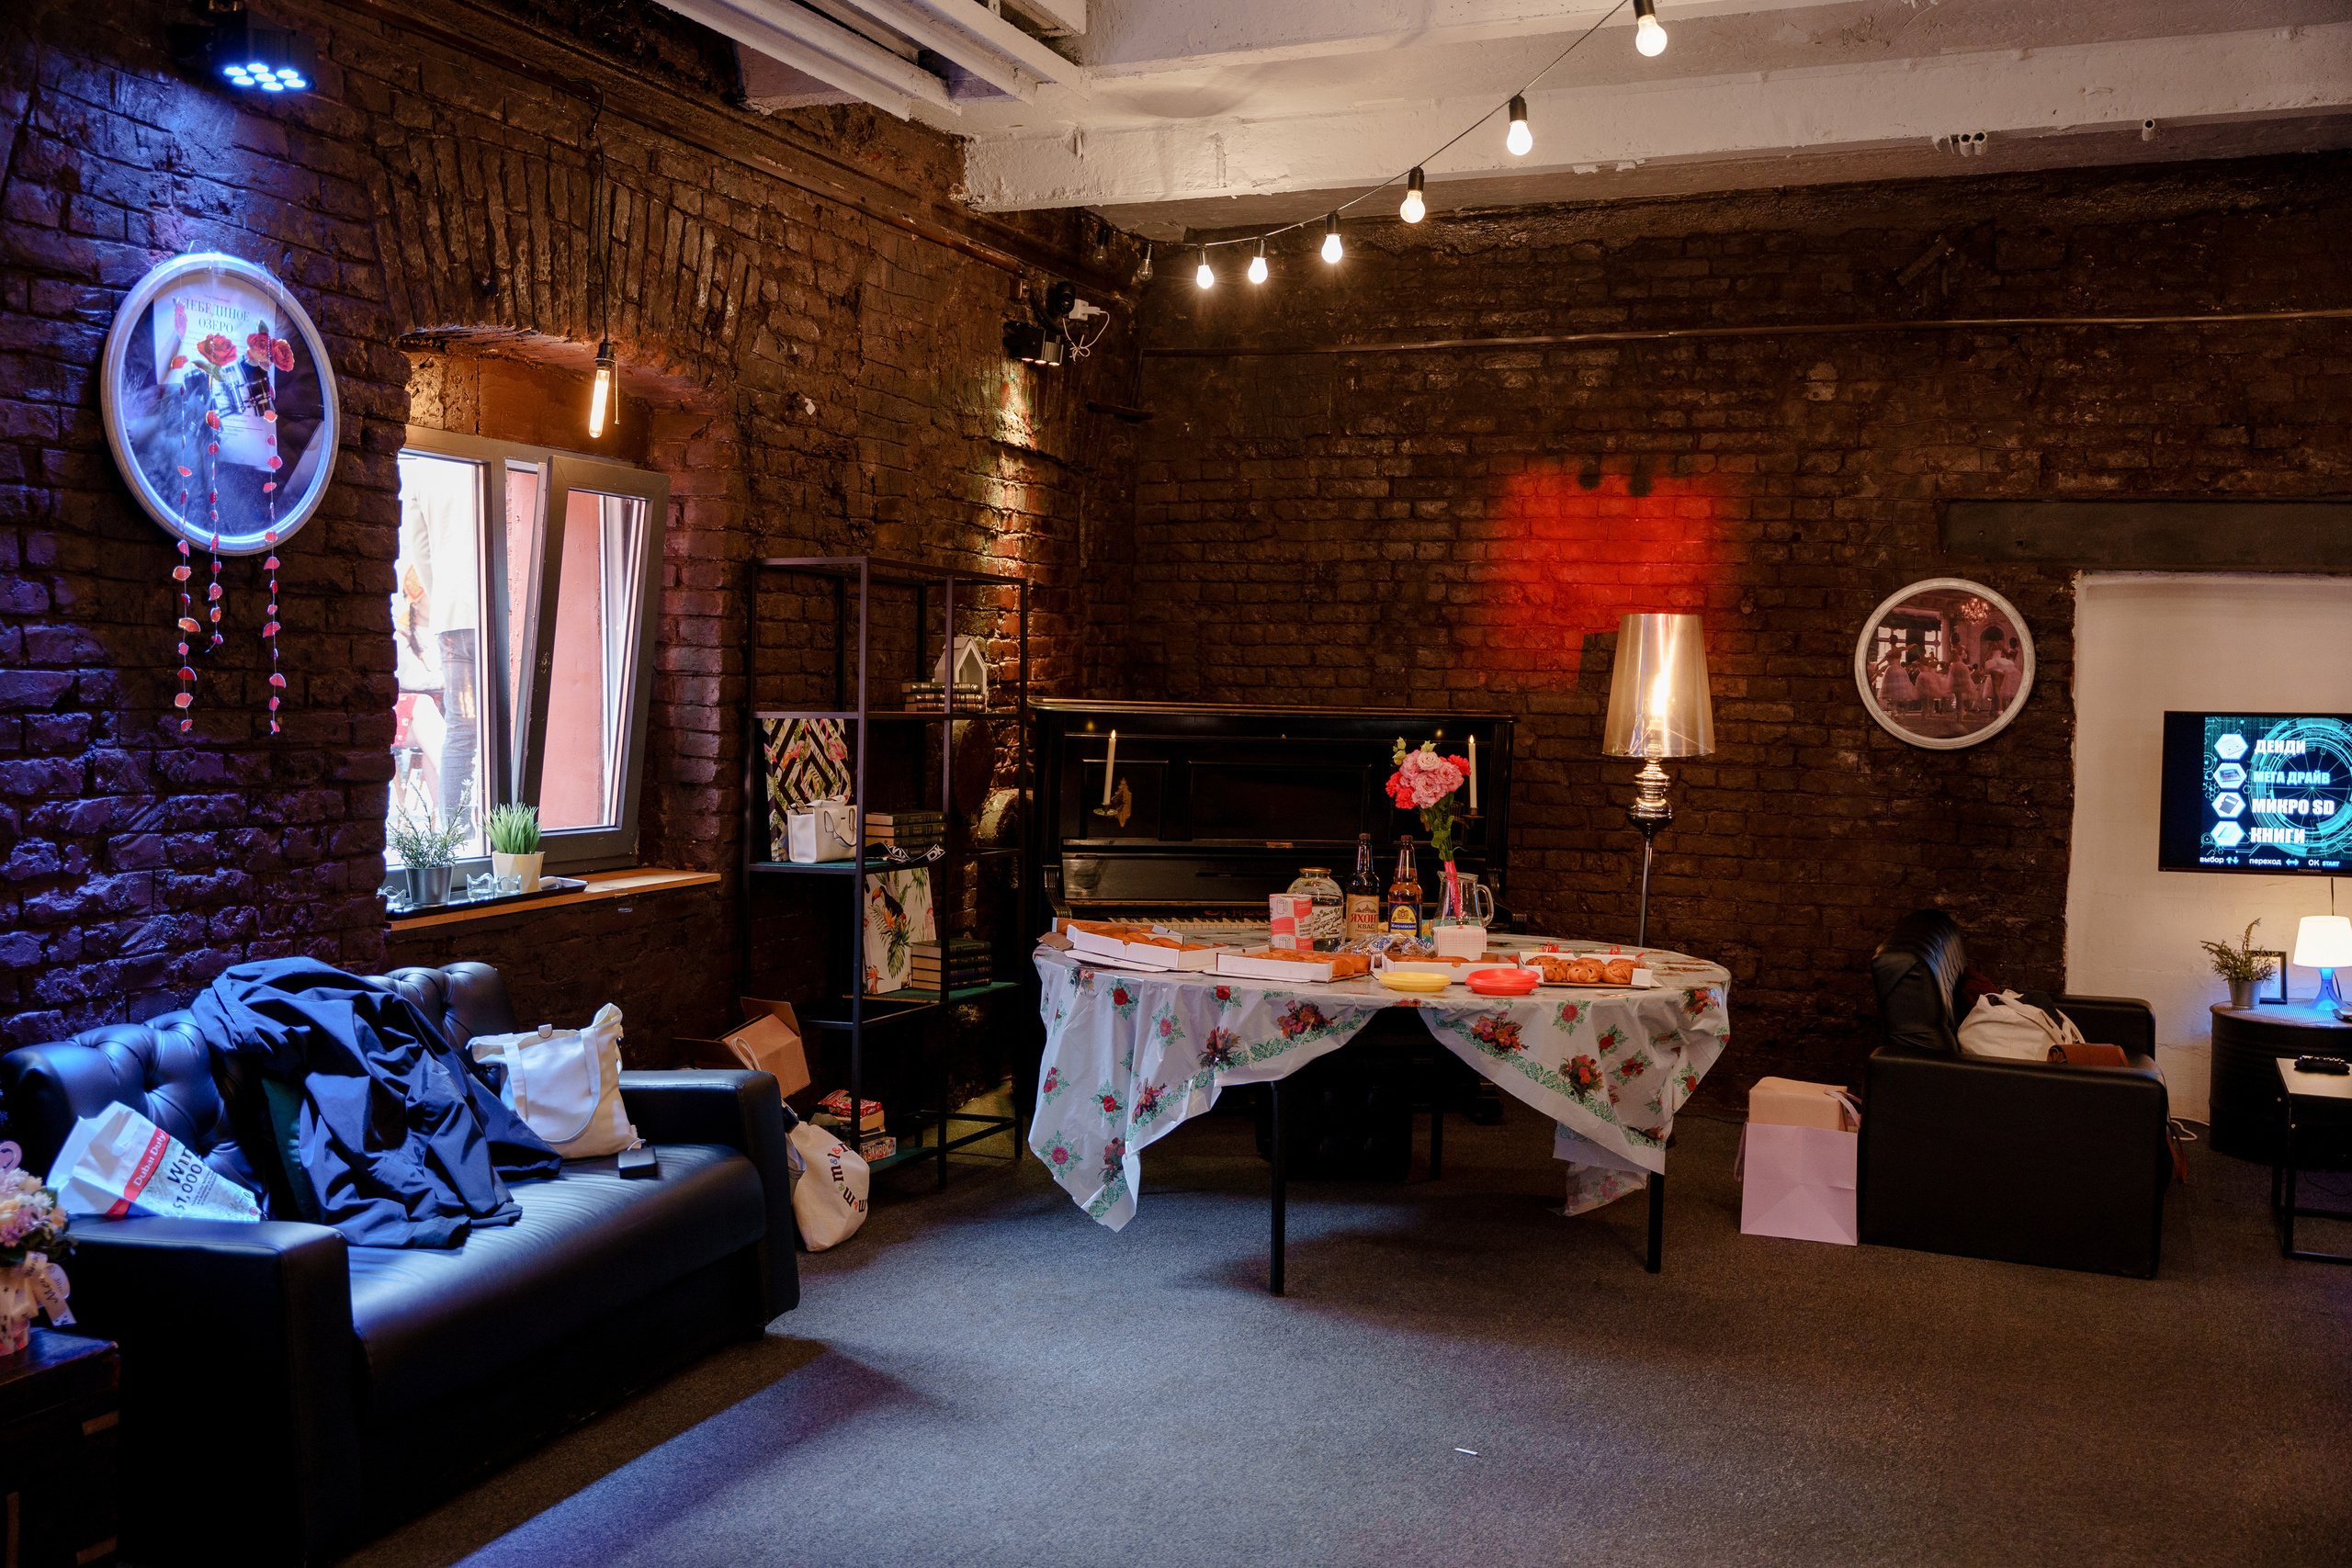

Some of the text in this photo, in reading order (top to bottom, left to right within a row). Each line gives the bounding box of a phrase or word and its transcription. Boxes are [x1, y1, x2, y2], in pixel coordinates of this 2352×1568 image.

[198, 318, 233, 333] ОЗЕРО
[2254, 739, 2306, 755] ДЕНДИ
[2253, 770, 2331, 785] МЕГА ДРАЙВ
[2252, 799, 2335, 815] МИКРО SD
[2250, 827, 2306, 843] КНИГИ
[2199, 856, 2224, 864] выбор
[150, 1133, 166, 1156] Duty
